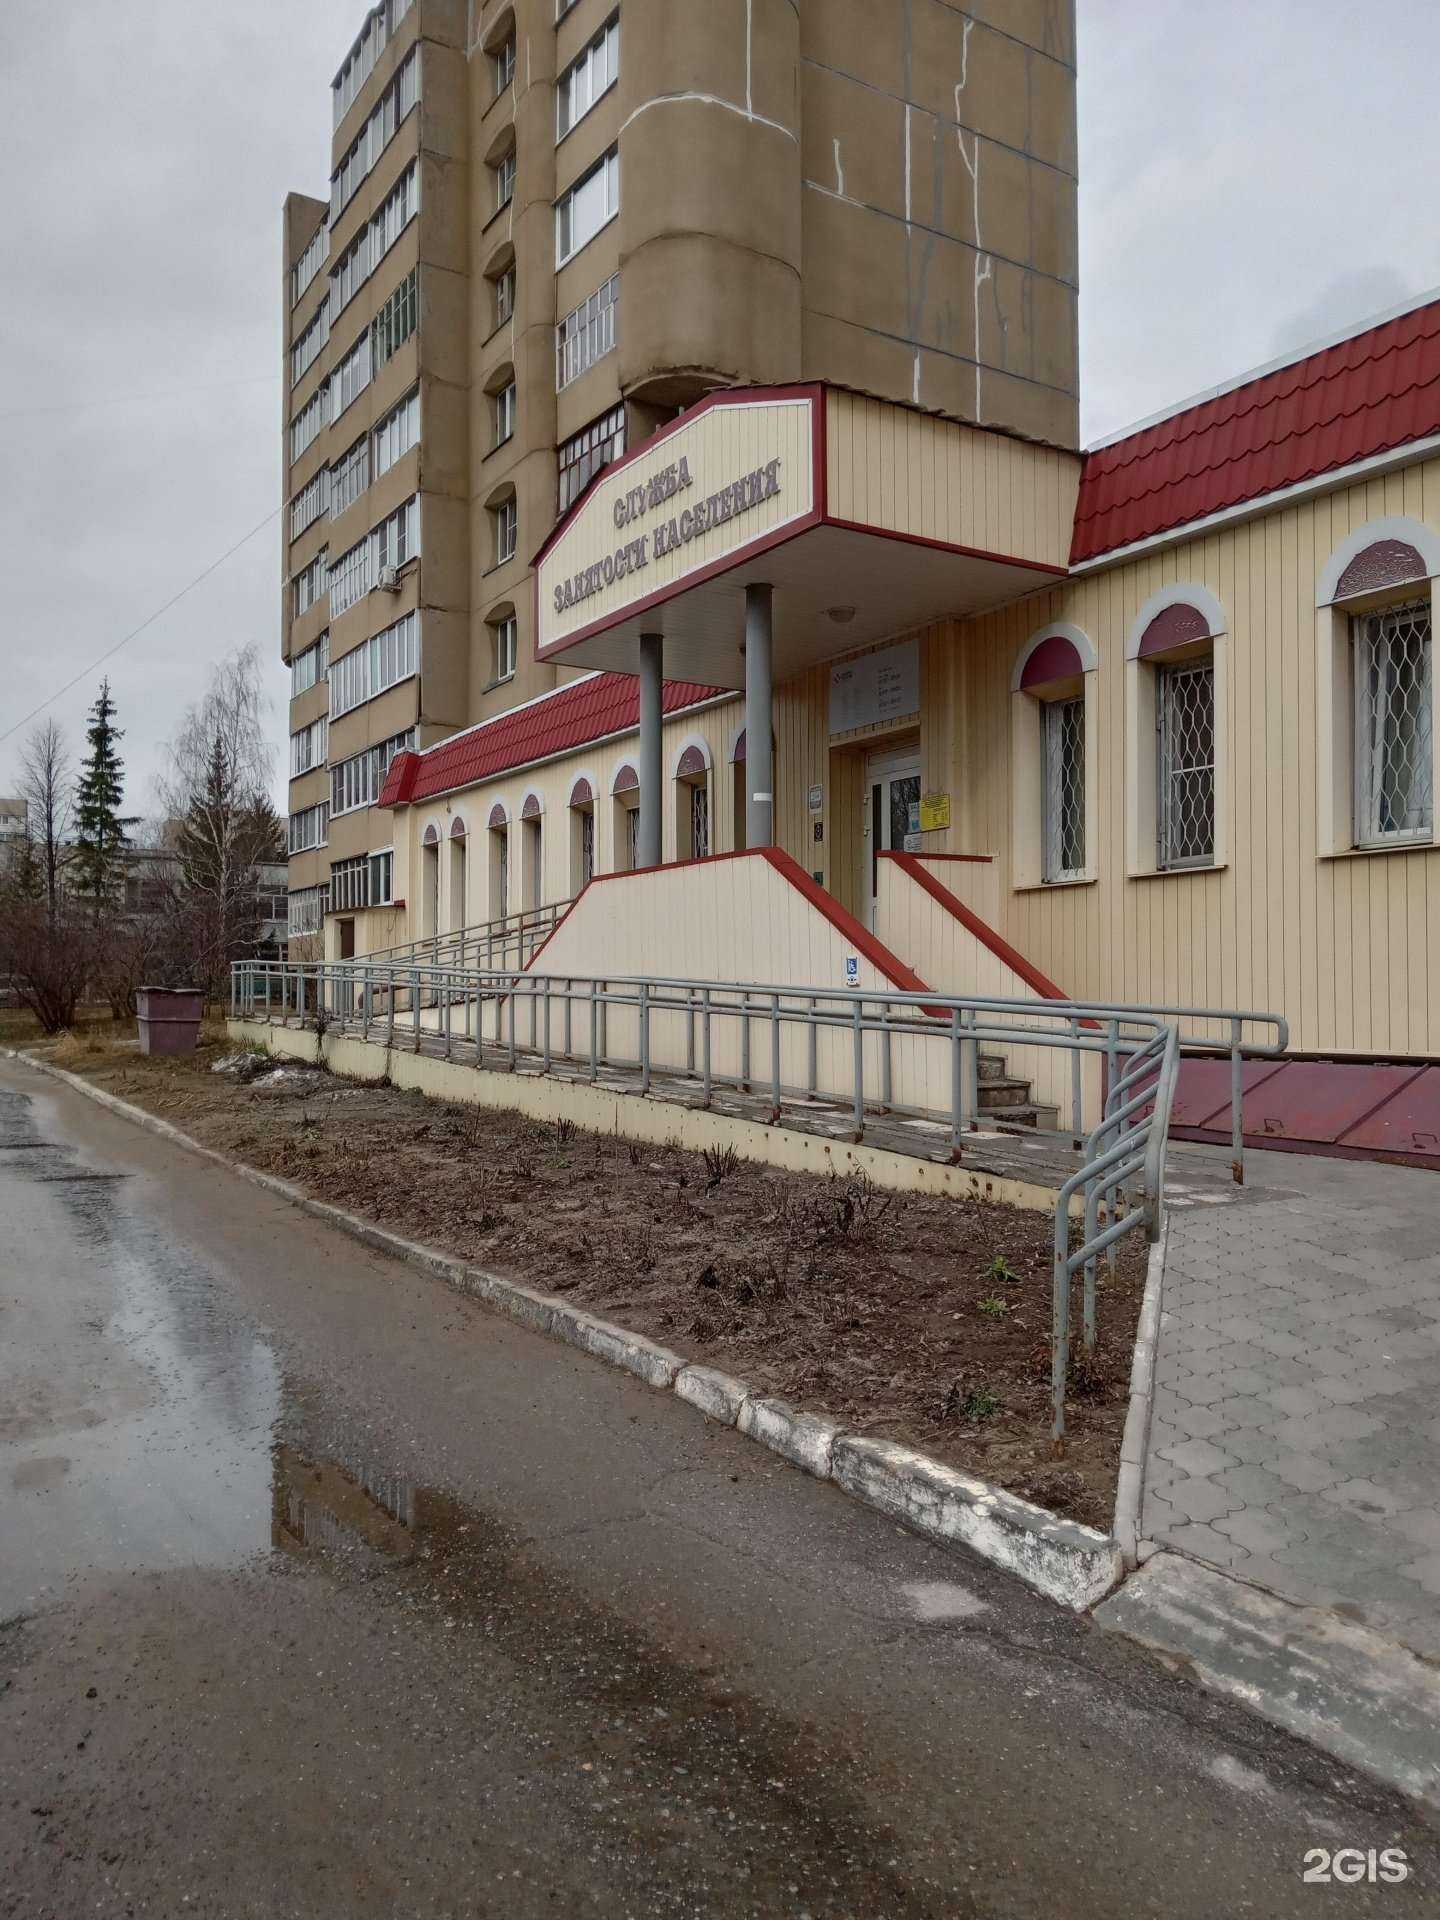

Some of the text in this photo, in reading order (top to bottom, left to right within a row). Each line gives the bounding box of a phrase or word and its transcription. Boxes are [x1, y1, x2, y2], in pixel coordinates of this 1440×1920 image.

[553, 456, 781, 613] ЗАНЯТОСТИ НАСЕЛЕНИЯ
[613, 455, 693, 529] СЛУЖБА
